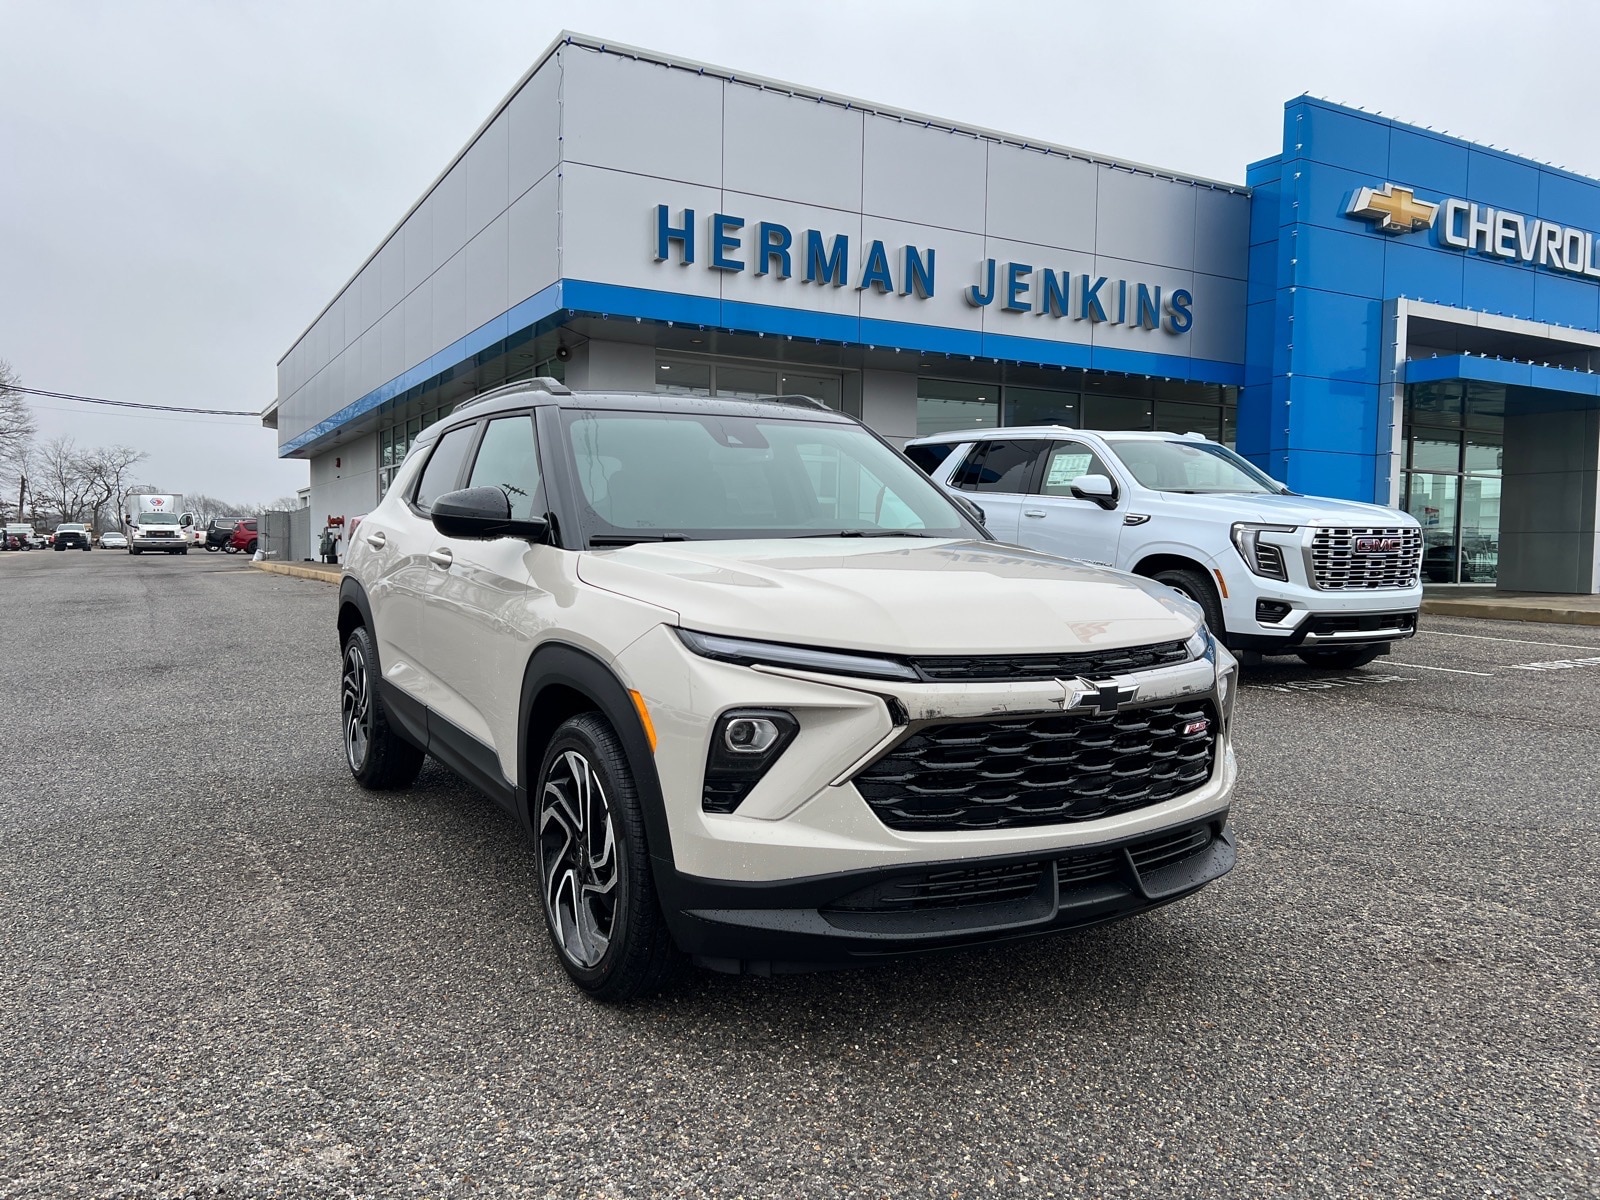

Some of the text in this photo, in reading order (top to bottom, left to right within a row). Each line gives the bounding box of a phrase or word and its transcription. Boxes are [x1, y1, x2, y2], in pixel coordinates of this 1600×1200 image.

[1441, 198, 1600, 277] CHEVROL
[653, 204, 1194, 334] HERMAN JENKINS
[1356, 538, 1401, 552] GMC
[1184, 721, 1207, 734] RS
